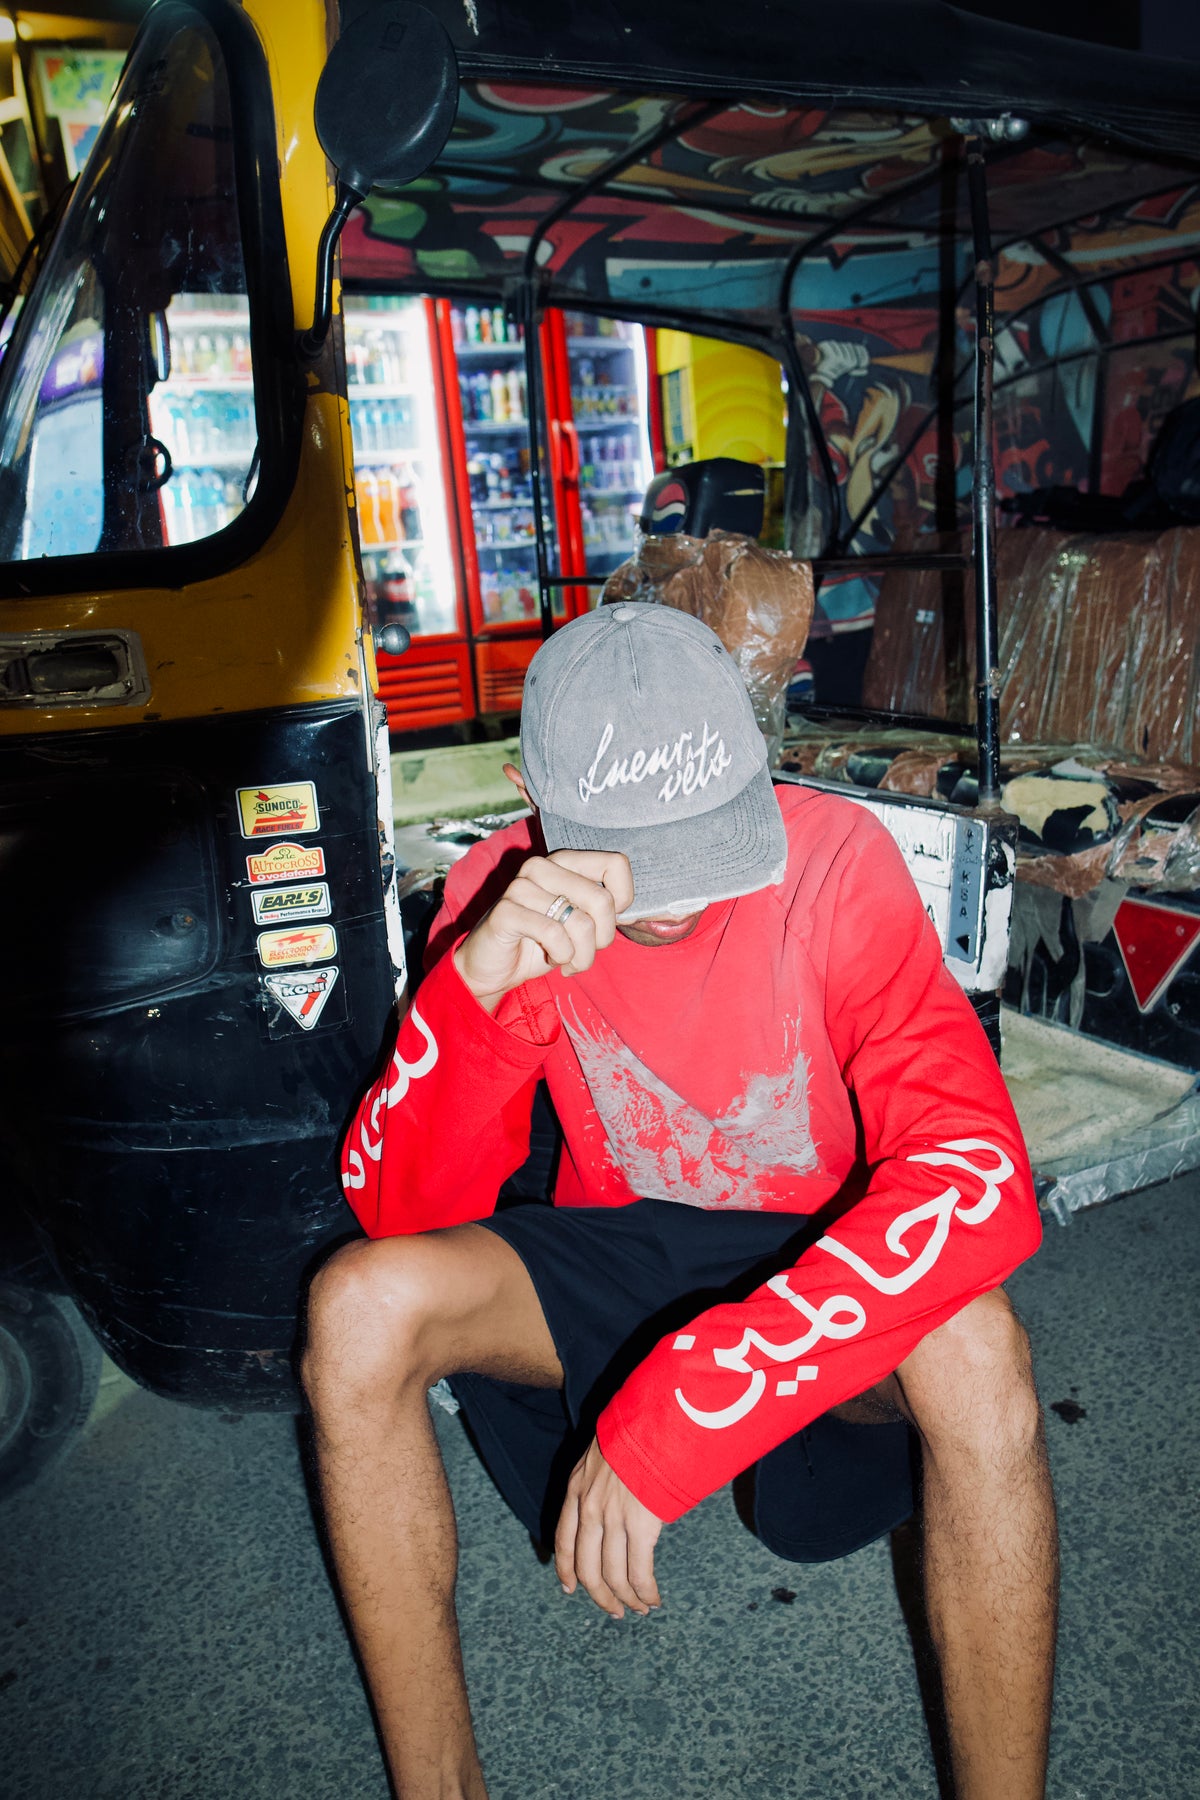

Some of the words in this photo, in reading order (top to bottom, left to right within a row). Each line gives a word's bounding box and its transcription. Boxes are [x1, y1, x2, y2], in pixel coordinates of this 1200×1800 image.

[257, 800, 300, 813] SUNOCO
[278, 823, 300, 831] FUELS
[253, 852, 319, 873] AUTOCROSS
[262, 891, 319, 909] EARL'S
[282, 982, 326, 997] KONI
